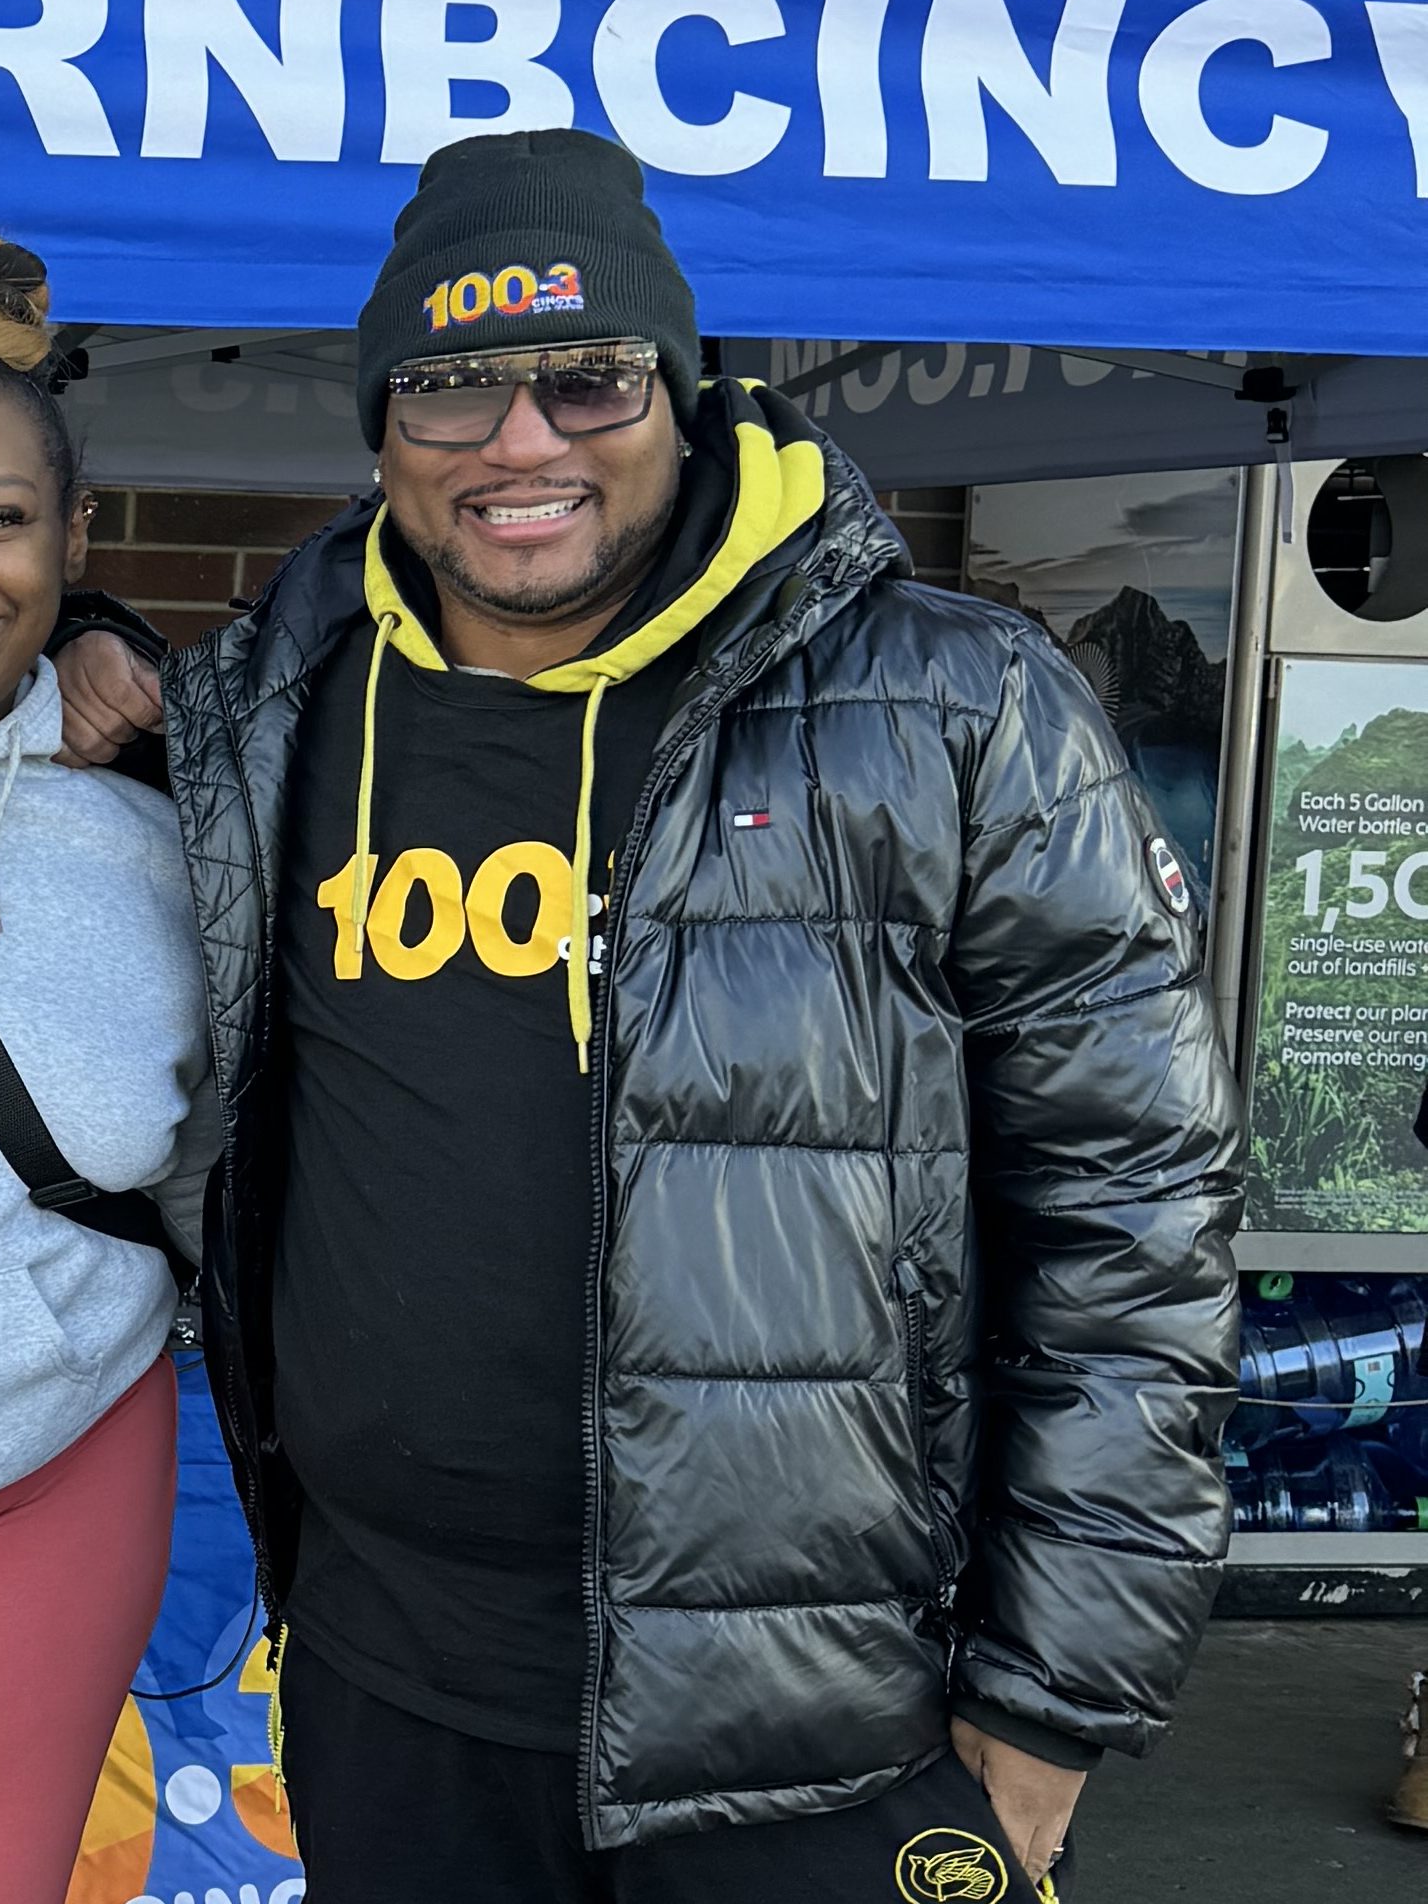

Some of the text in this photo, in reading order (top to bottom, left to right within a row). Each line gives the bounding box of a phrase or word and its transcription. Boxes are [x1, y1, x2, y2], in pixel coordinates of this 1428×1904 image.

[423, 263, 580, 332] 100.3
[1301, 791, 1425, 813] Each 5 Gallon
[1299, 815, 1428, 835] Water bottle c
[317, 841, 615, 980] 100.
[1289, 933, 1386, 956] single-use
[1288, 960, 1319, 974] out
[1322, 957, 1343, 975] of
[1345, 958, 1416, 976] landfills
[1286, 1001, 1352, 1020] Protect
[1355, 1007, 1389, 1021] our
[1284, 1024, 1365, 1043] Preserve
[1368, 1029, 1401, 1043] our
[1282, 1047, 1428, 1072] Promote chang
